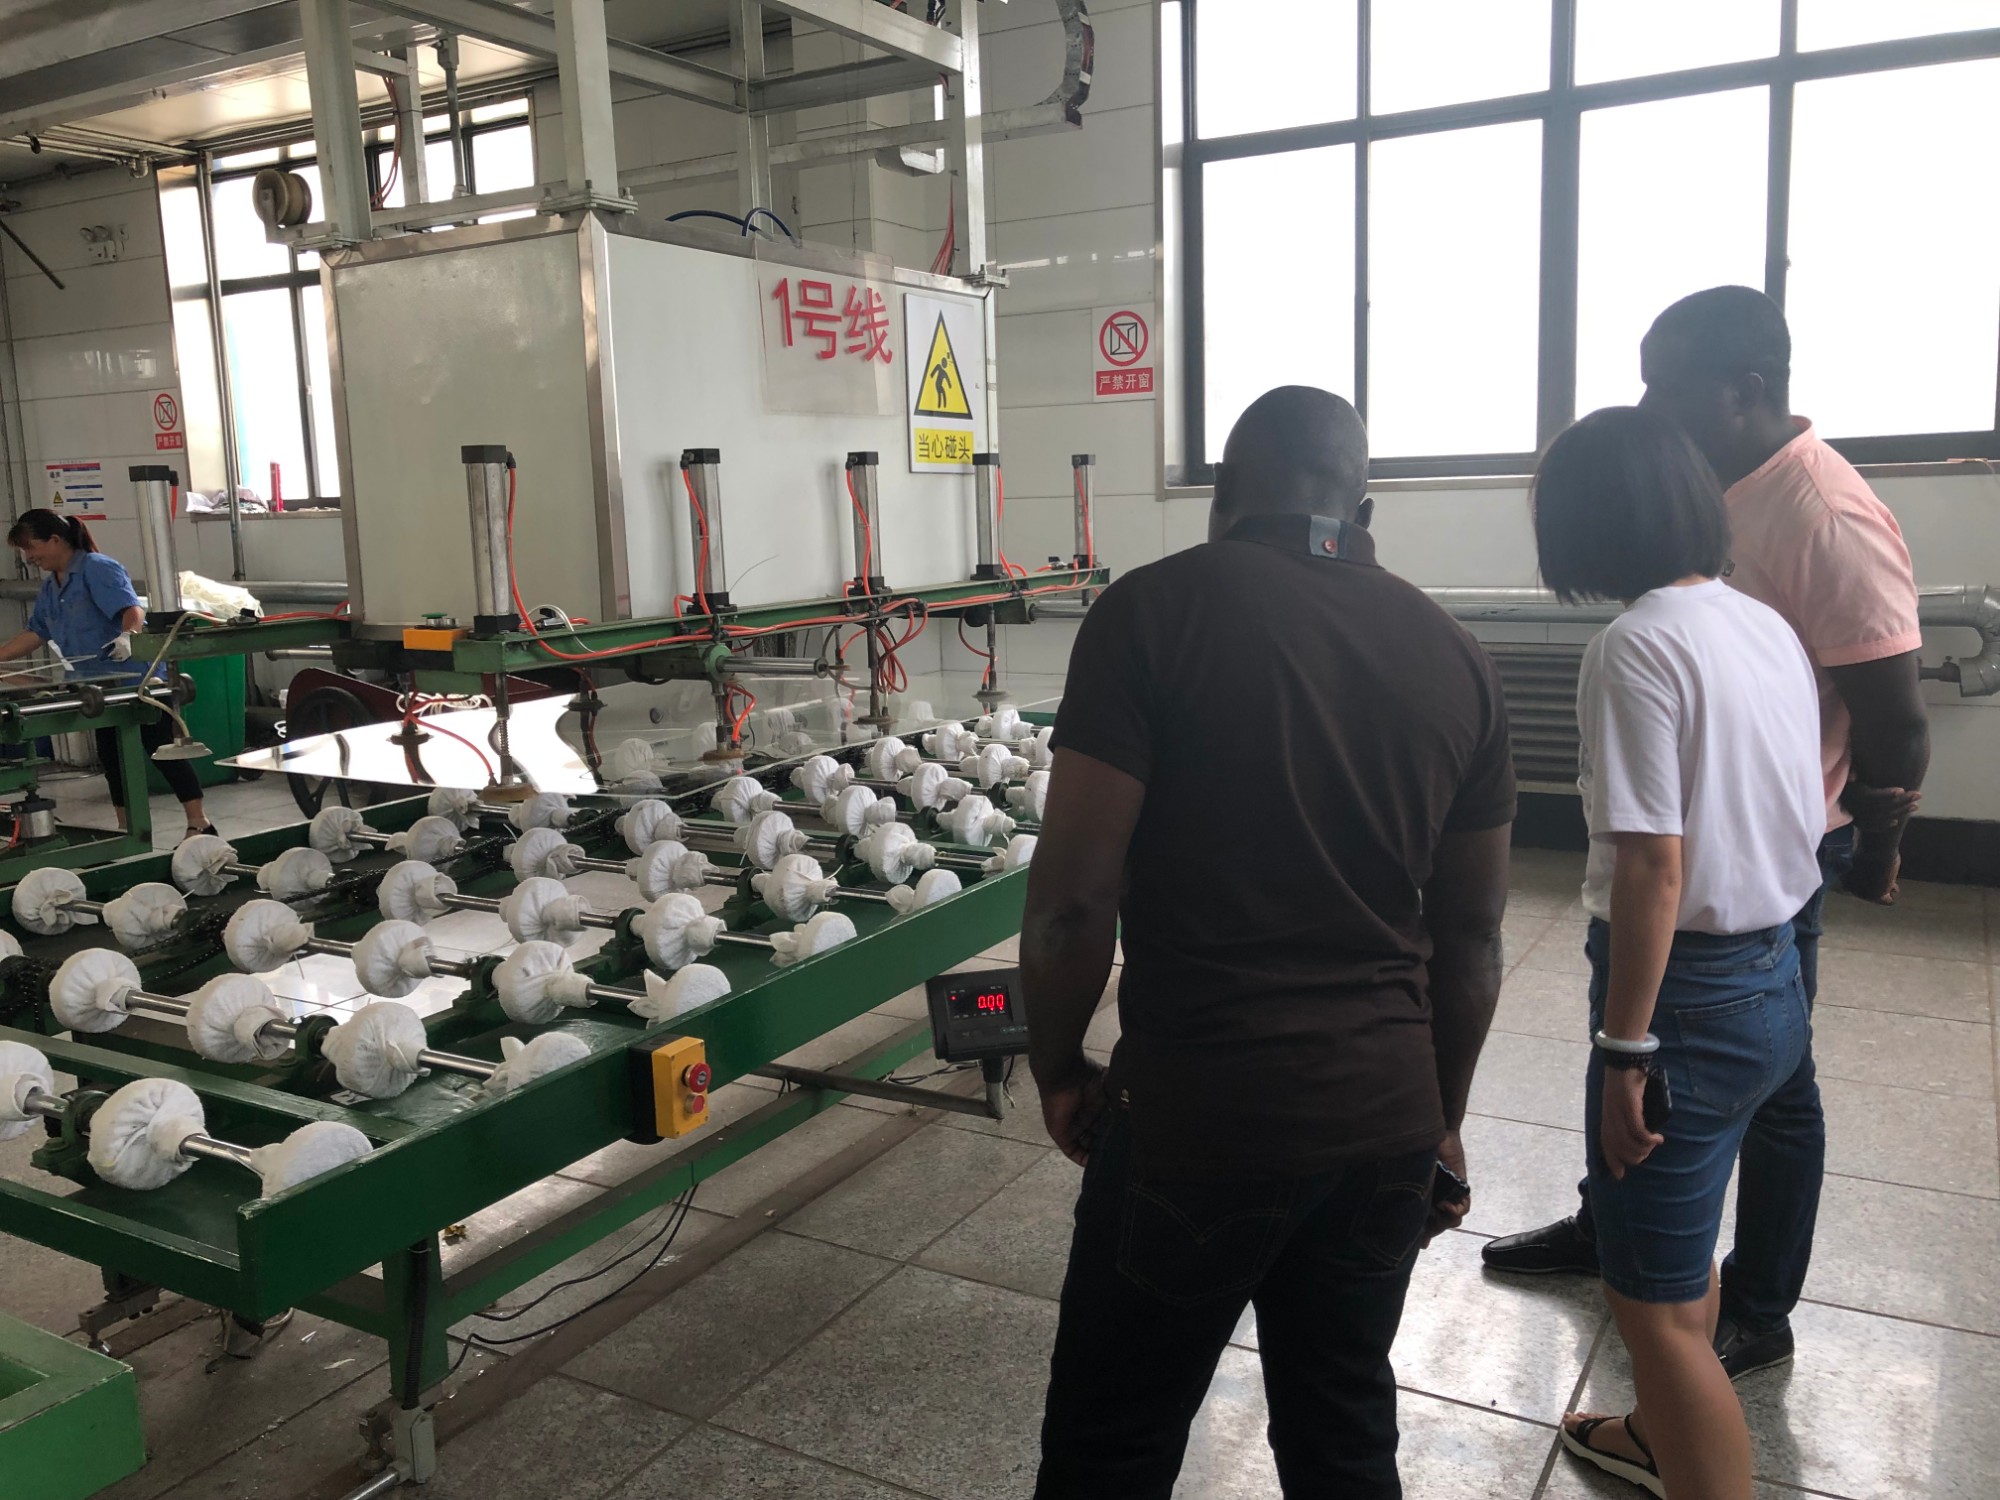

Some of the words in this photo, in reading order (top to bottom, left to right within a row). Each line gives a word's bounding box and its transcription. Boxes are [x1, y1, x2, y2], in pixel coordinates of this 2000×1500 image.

[772, 278, 893, 364] 1号线
[1099, 373, 1150, 391] 严禁开窗
[918, 433, 970, 459] 当心碰头
[978, 994, 1004, 1009] 0.00
